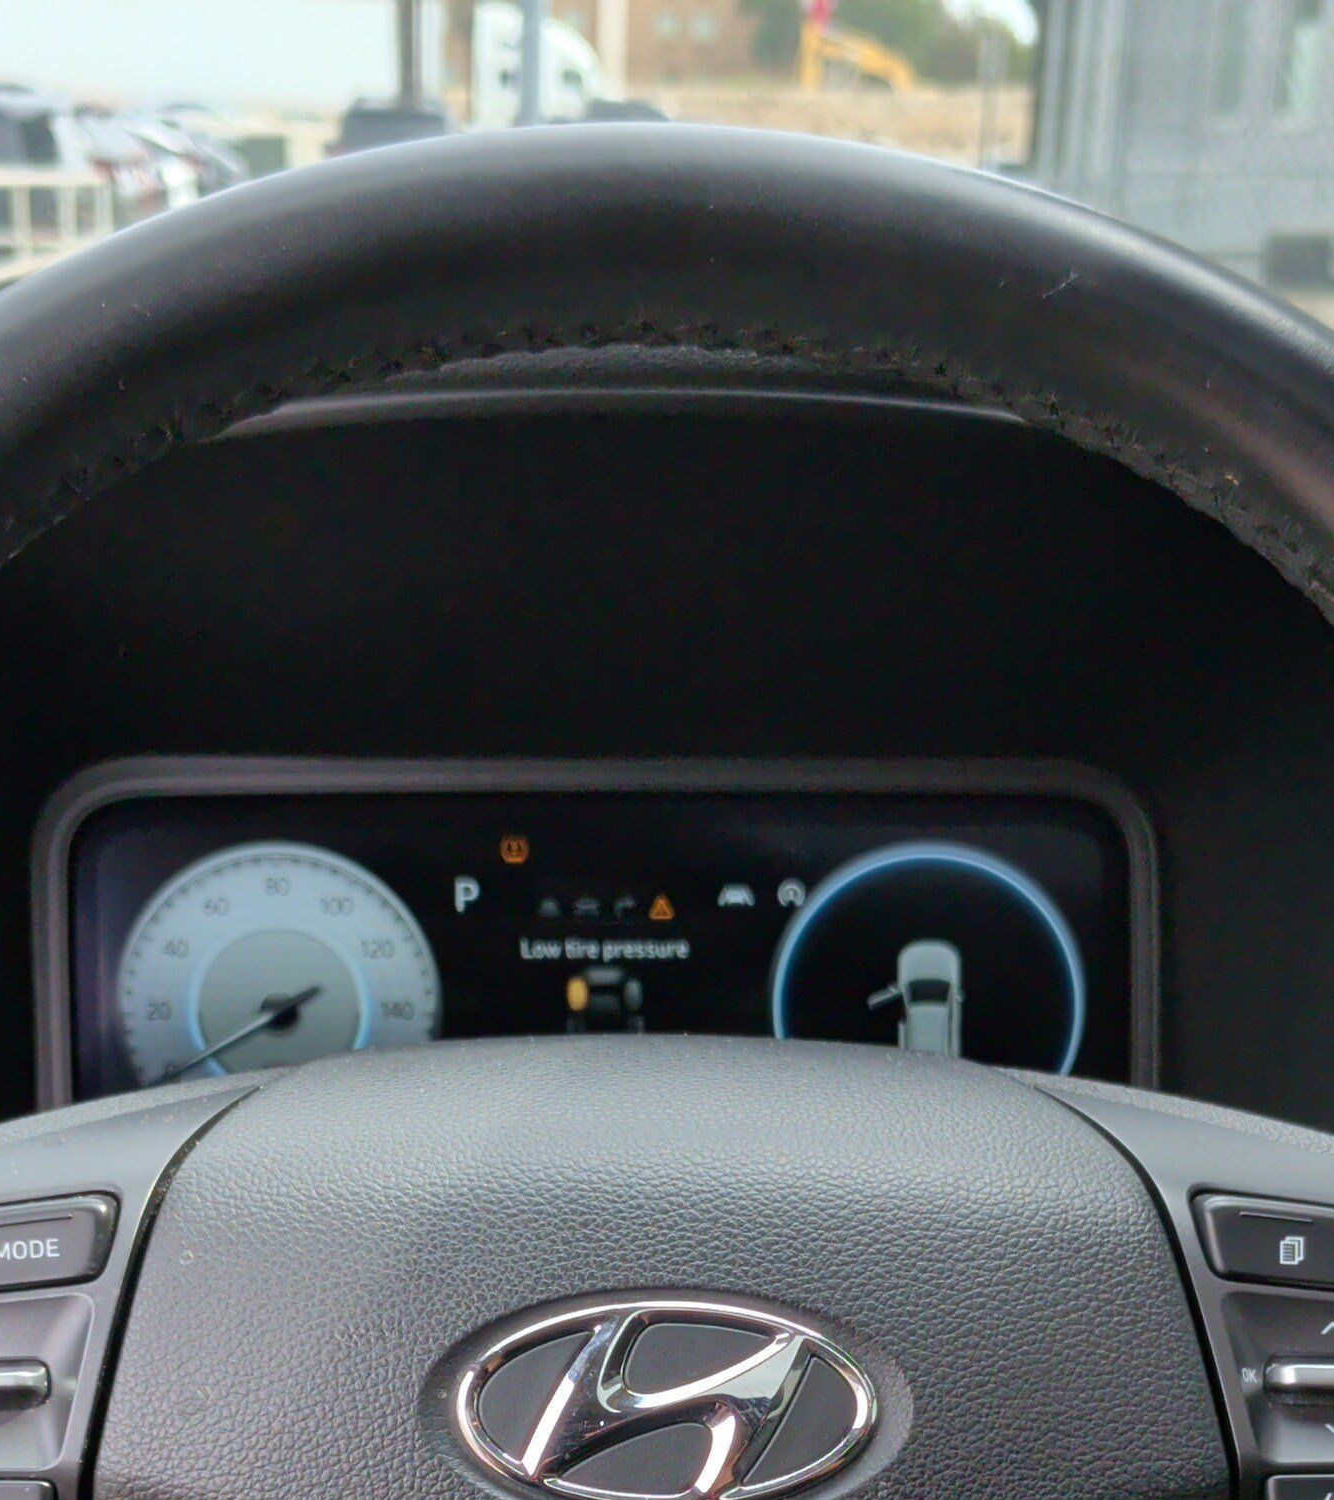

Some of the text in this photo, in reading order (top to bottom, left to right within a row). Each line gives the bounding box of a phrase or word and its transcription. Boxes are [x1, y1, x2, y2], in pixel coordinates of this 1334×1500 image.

[265, 876, 291, 896] 80
[454, 876, 481, 914] P
[203, 897, 229, 916] 60
[319, 896, 355, 916] 100
[361, 939, 395, 960] 120
[519, 935, 691, 964] Low tire pressure
[147, 1000, 173, 1021] 20
[1241, 1367, 1258, 1384] OK
